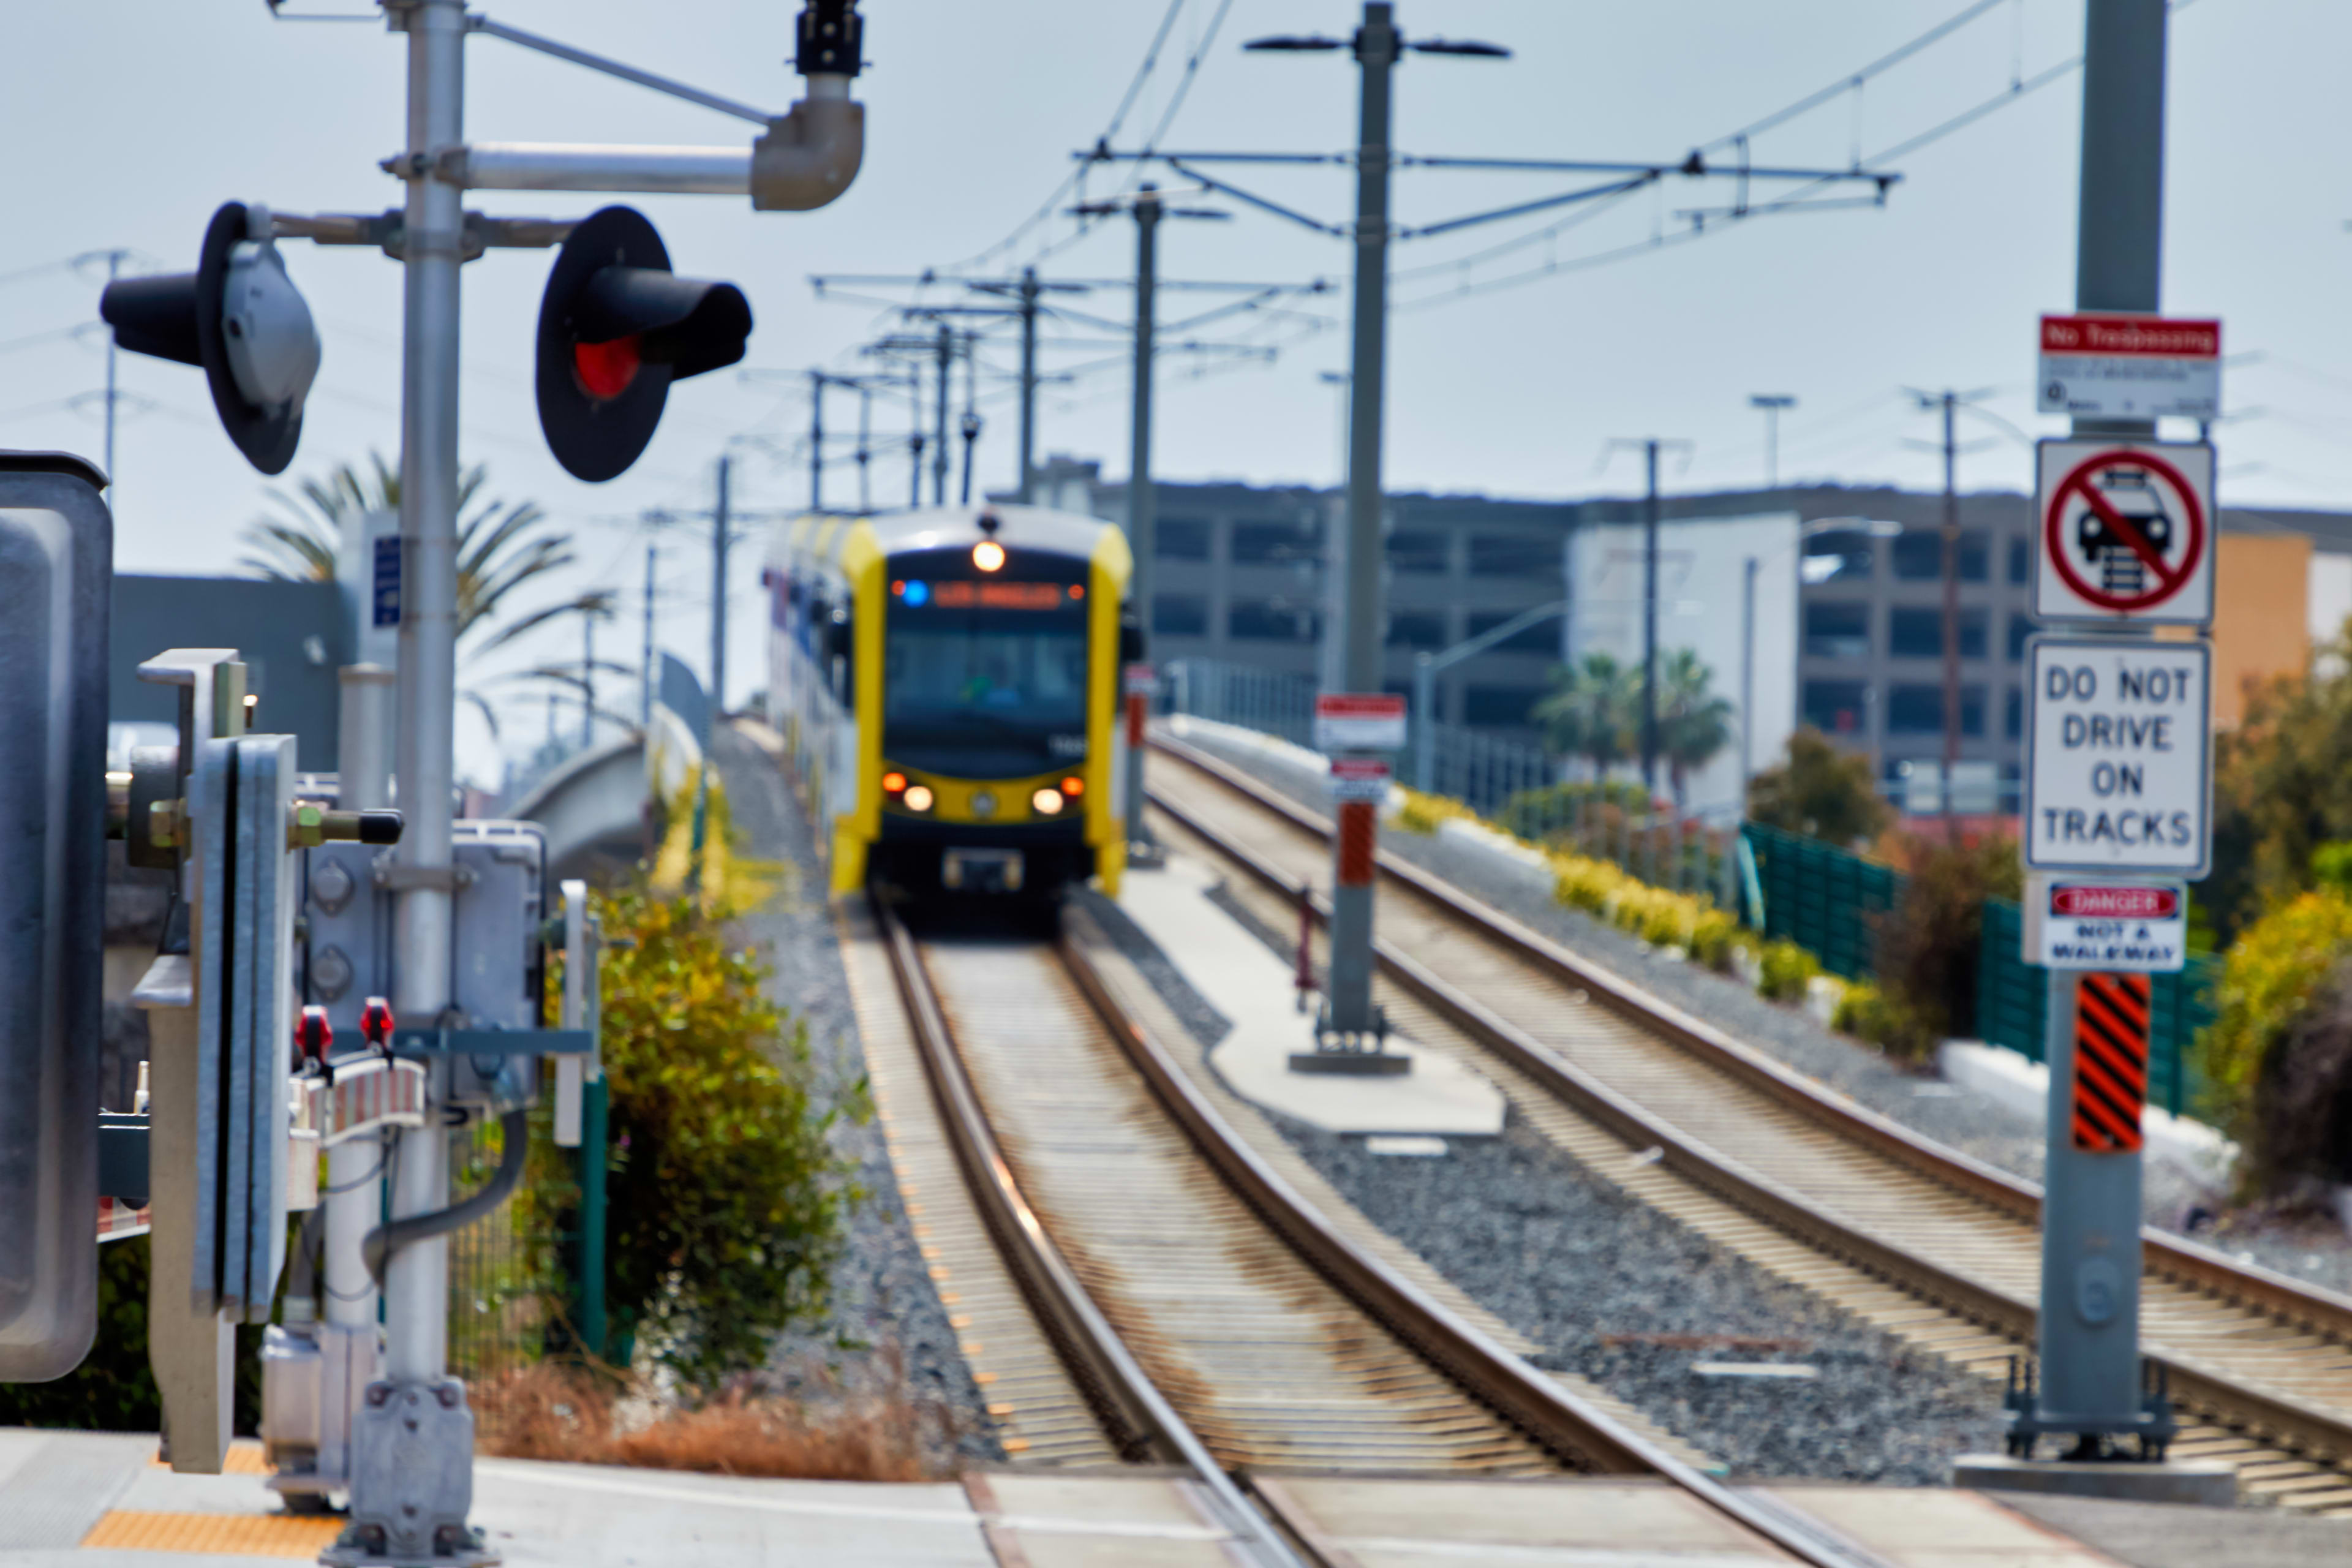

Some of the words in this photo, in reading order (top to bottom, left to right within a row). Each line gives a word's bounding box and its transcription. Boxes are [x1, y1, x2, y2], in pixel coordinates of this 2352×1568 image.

[2047, 322, 2079, 347] No
[2046, 665, 2097, 702] DO
[2118, 666, 2192, 704] NOT
[2062, 713, 2174, 752] DRIVE
[2090, 761, 2144, 797] ON
[2043, 807, 2192, 846] TRACKS
[2071, 889, 2158, 912] DANGER
[2076, 923, 2124, 938] NOT
[2136, 924, 2150, 940] A
[2052, 944, 2174, 960] WALKWAY
